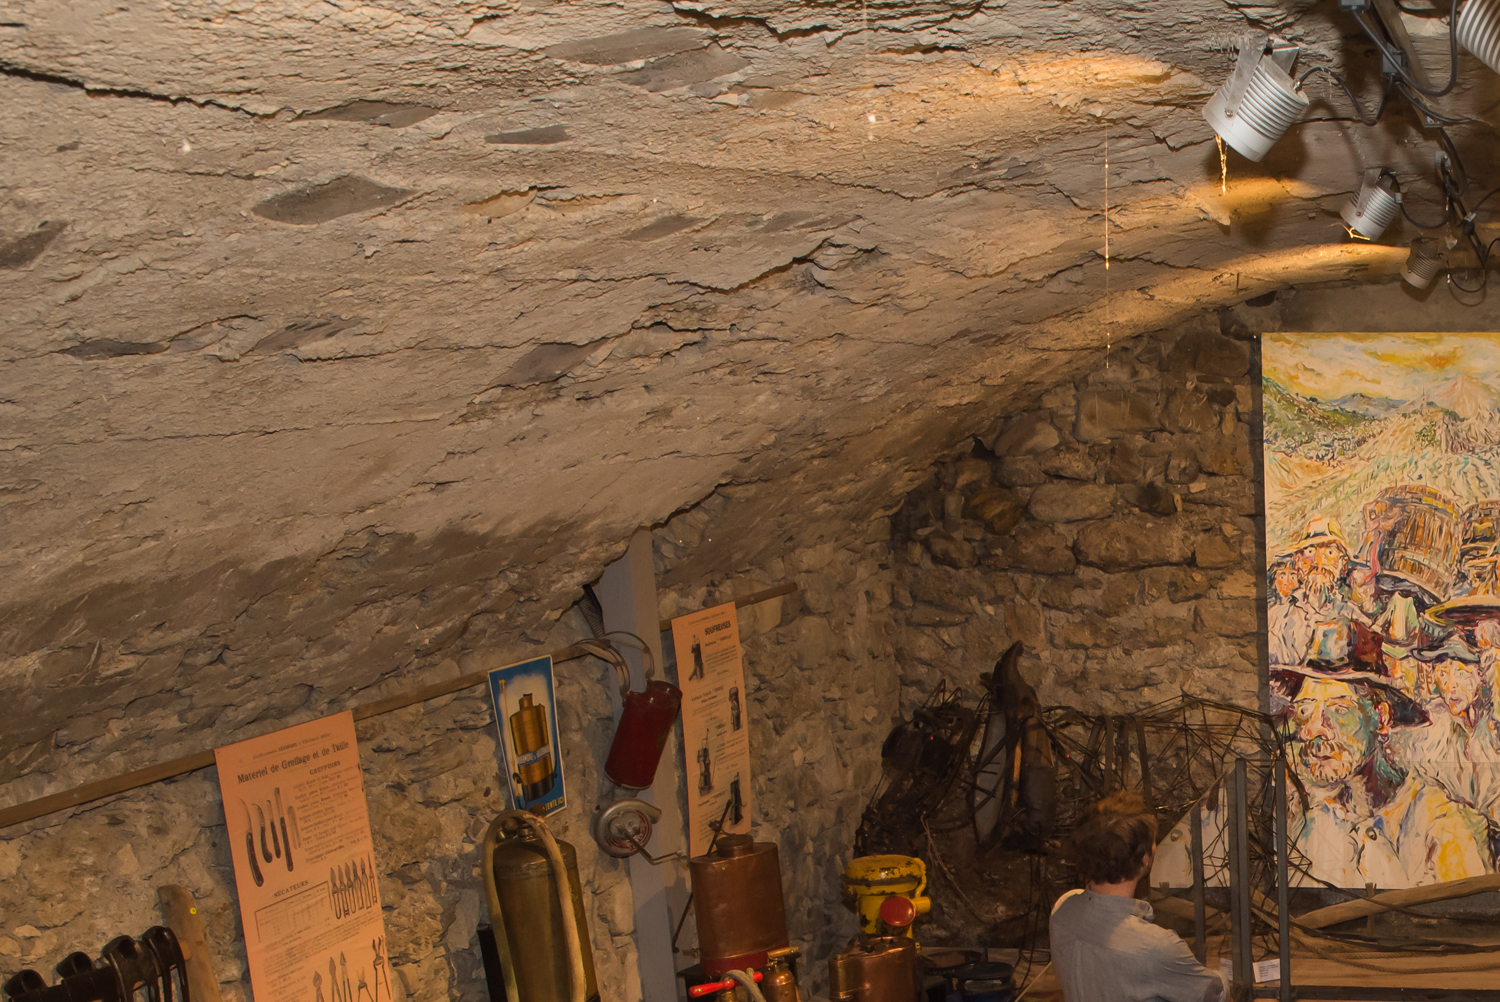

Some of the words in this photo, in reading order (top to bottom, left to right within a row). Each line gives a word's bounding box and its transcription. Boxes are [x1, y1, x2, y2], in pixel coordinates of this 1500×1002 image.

[269, 762, 279, 773] de
[311, 750, 319, 760] et
[321, 746, 330, 757] de
[331, 740, 349, 753] Taille
